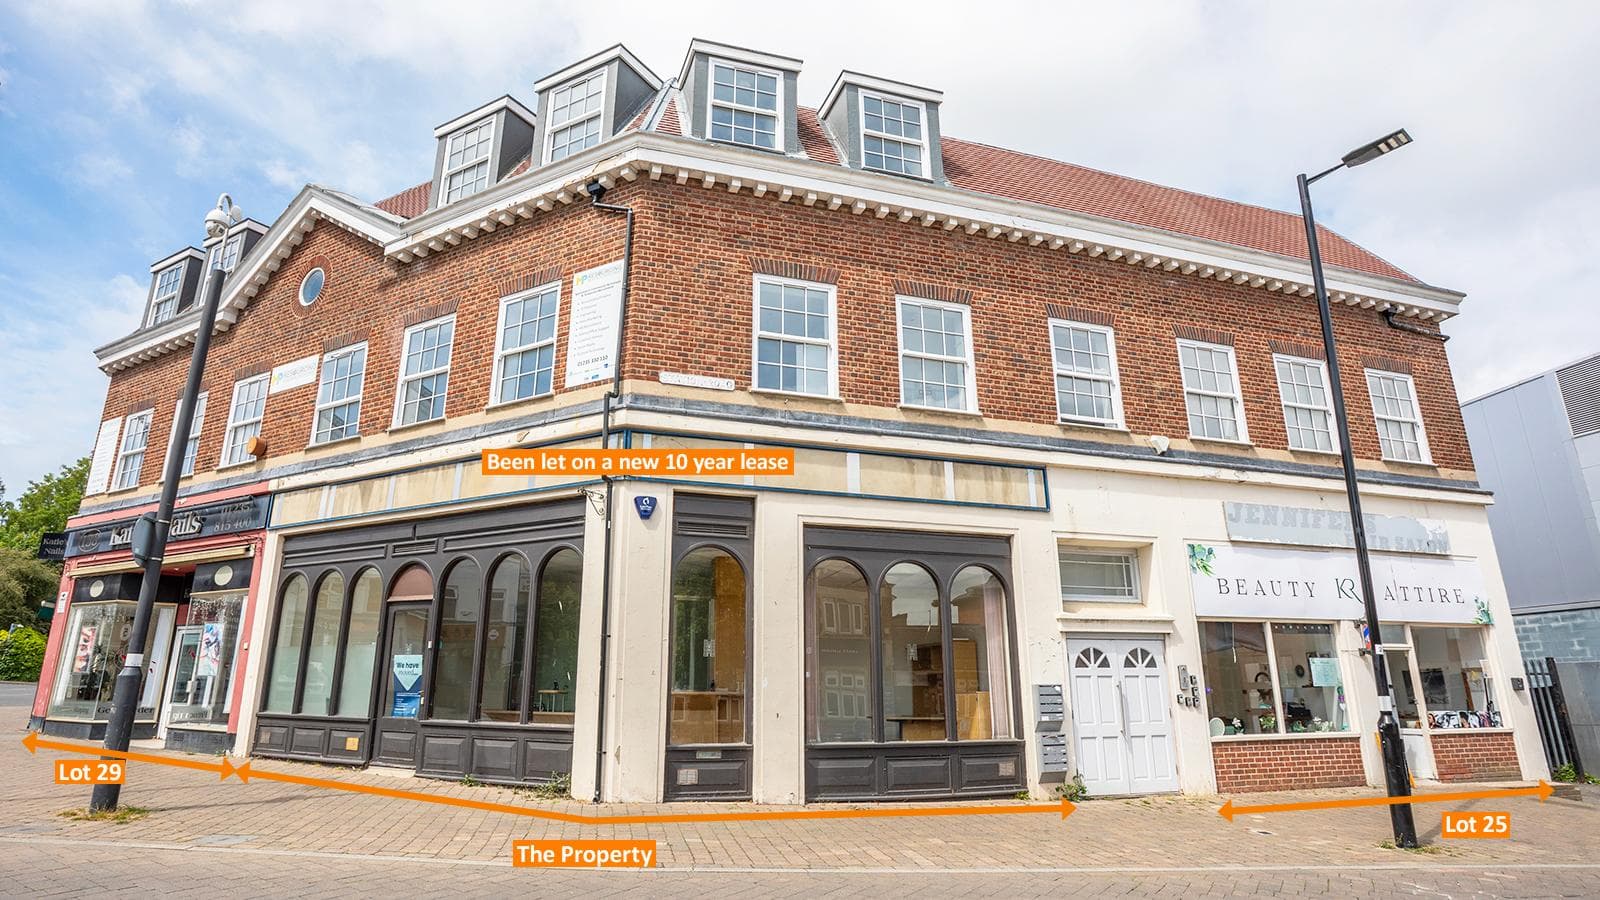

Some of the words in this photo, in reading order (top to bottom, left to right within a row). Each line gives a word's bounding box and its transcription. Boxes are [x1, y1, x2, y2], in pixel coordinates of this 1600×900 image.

[169, 512, 202, 536] ails
[1345, 532, 1389, 549] HIR
[1217, 577, 1316, 598] BEAUTY
[1384, 586, 1466, 604] ATTIRE
